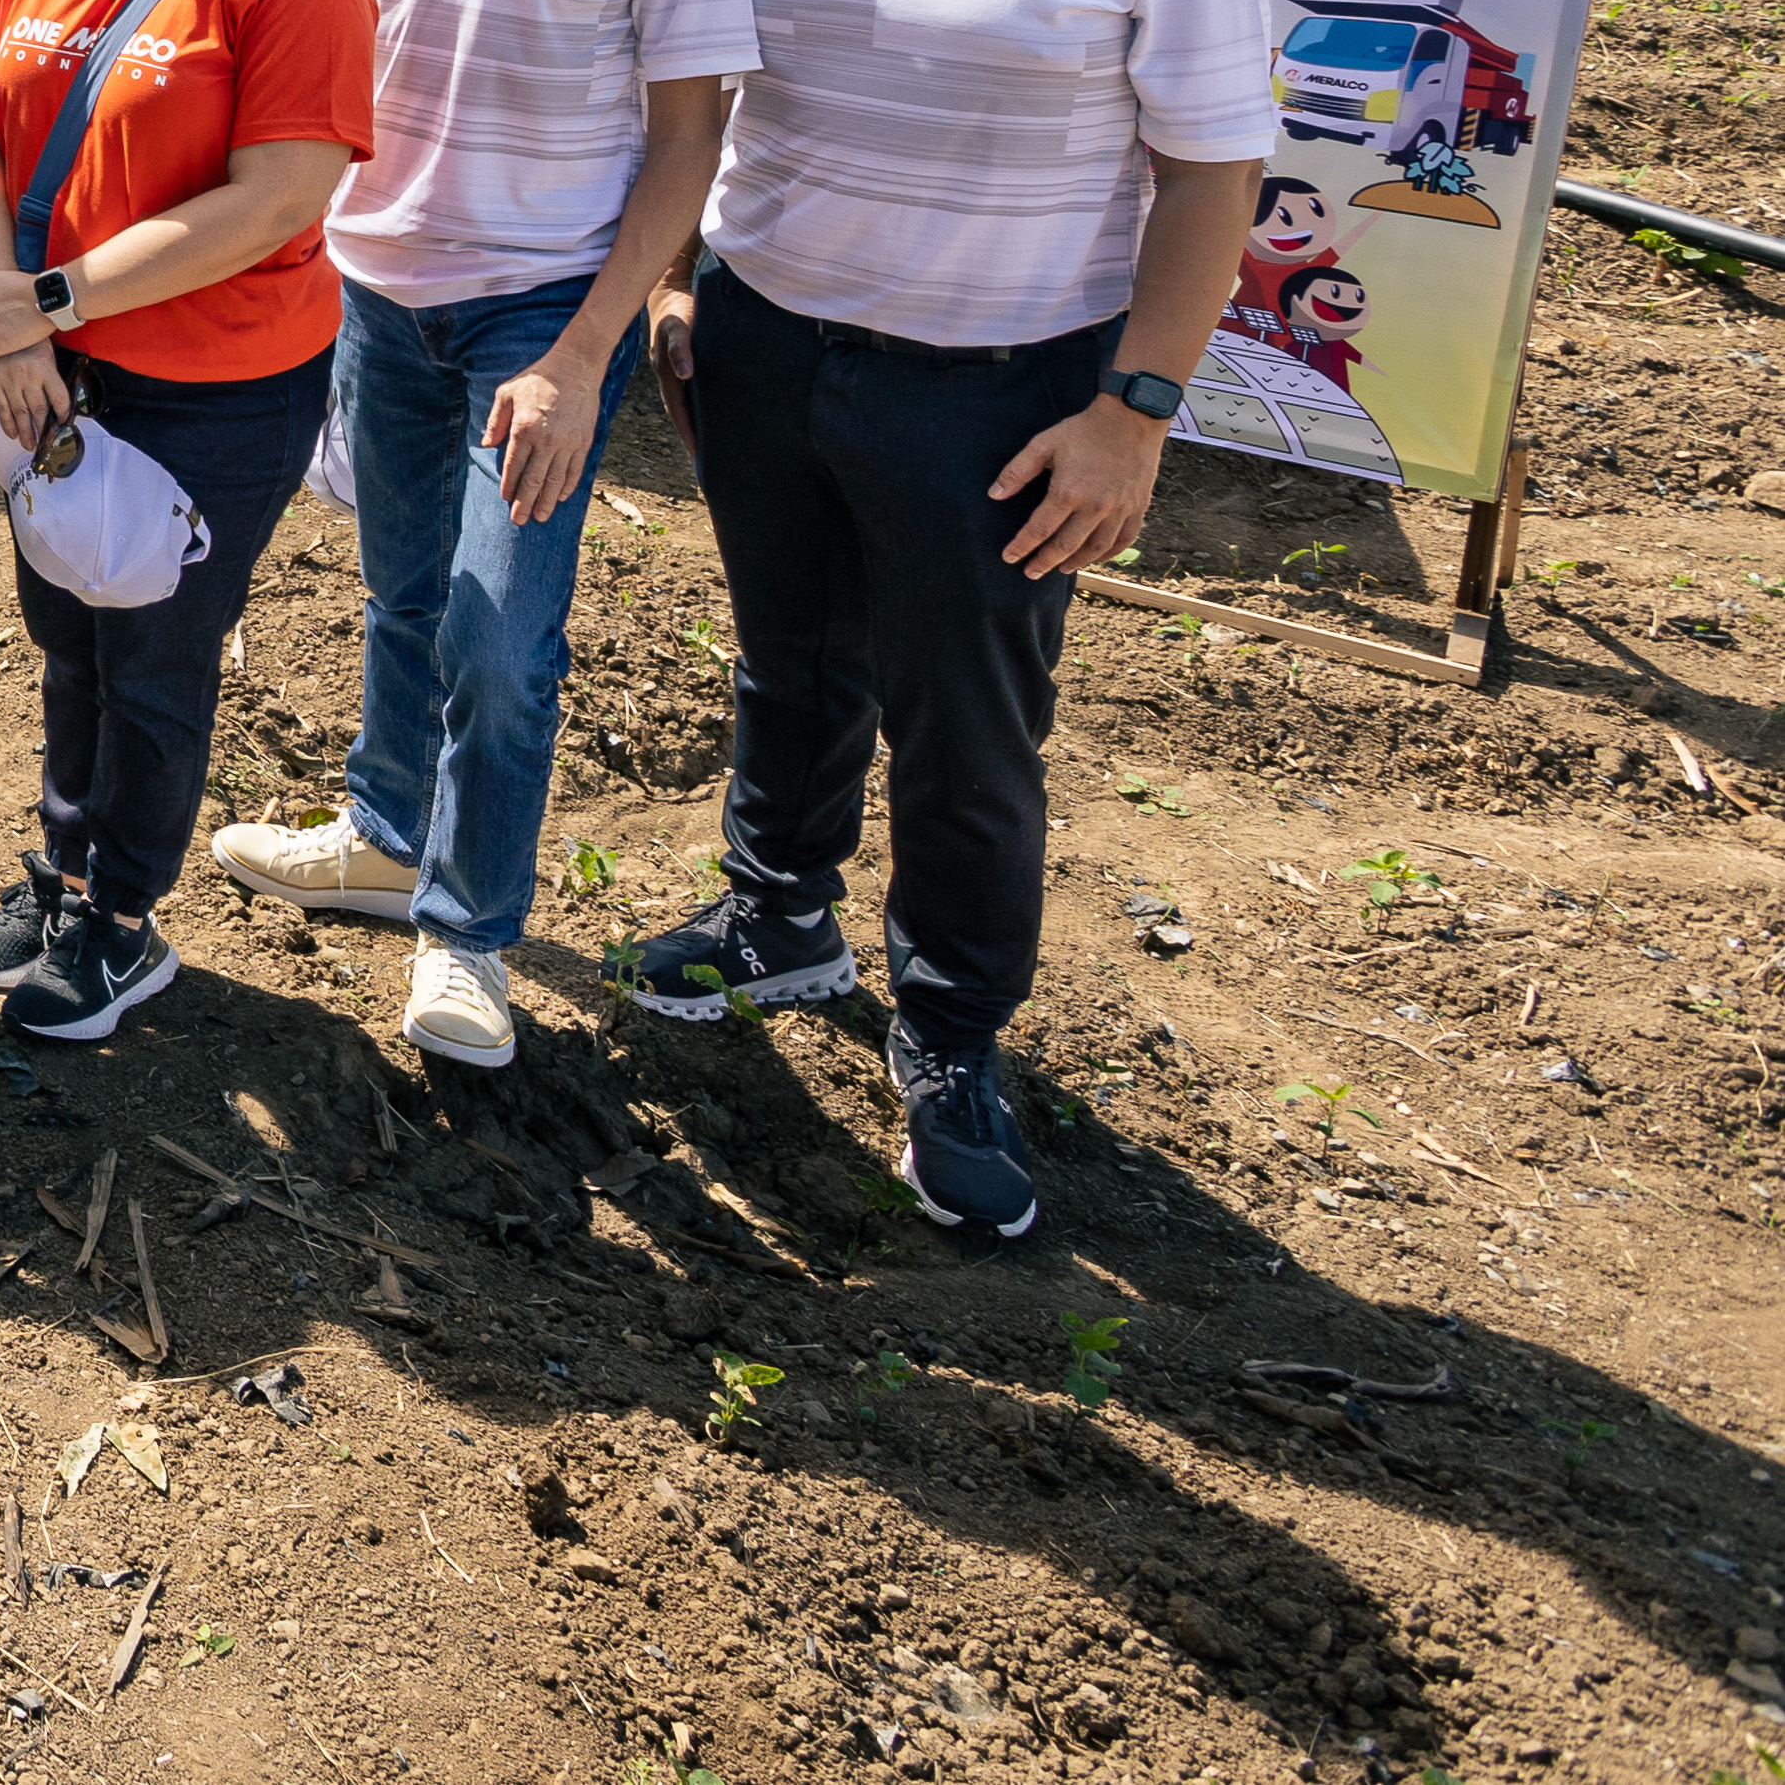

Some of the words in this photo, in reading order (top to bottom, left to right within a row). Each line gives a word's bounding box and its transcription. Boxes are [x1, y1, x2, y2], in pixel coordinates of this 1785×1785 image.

[12, 16, 64, 46] ONE
[2, 48, 168, 87] FOUNION
[1303, 73, 1369, 92] MERALCO
